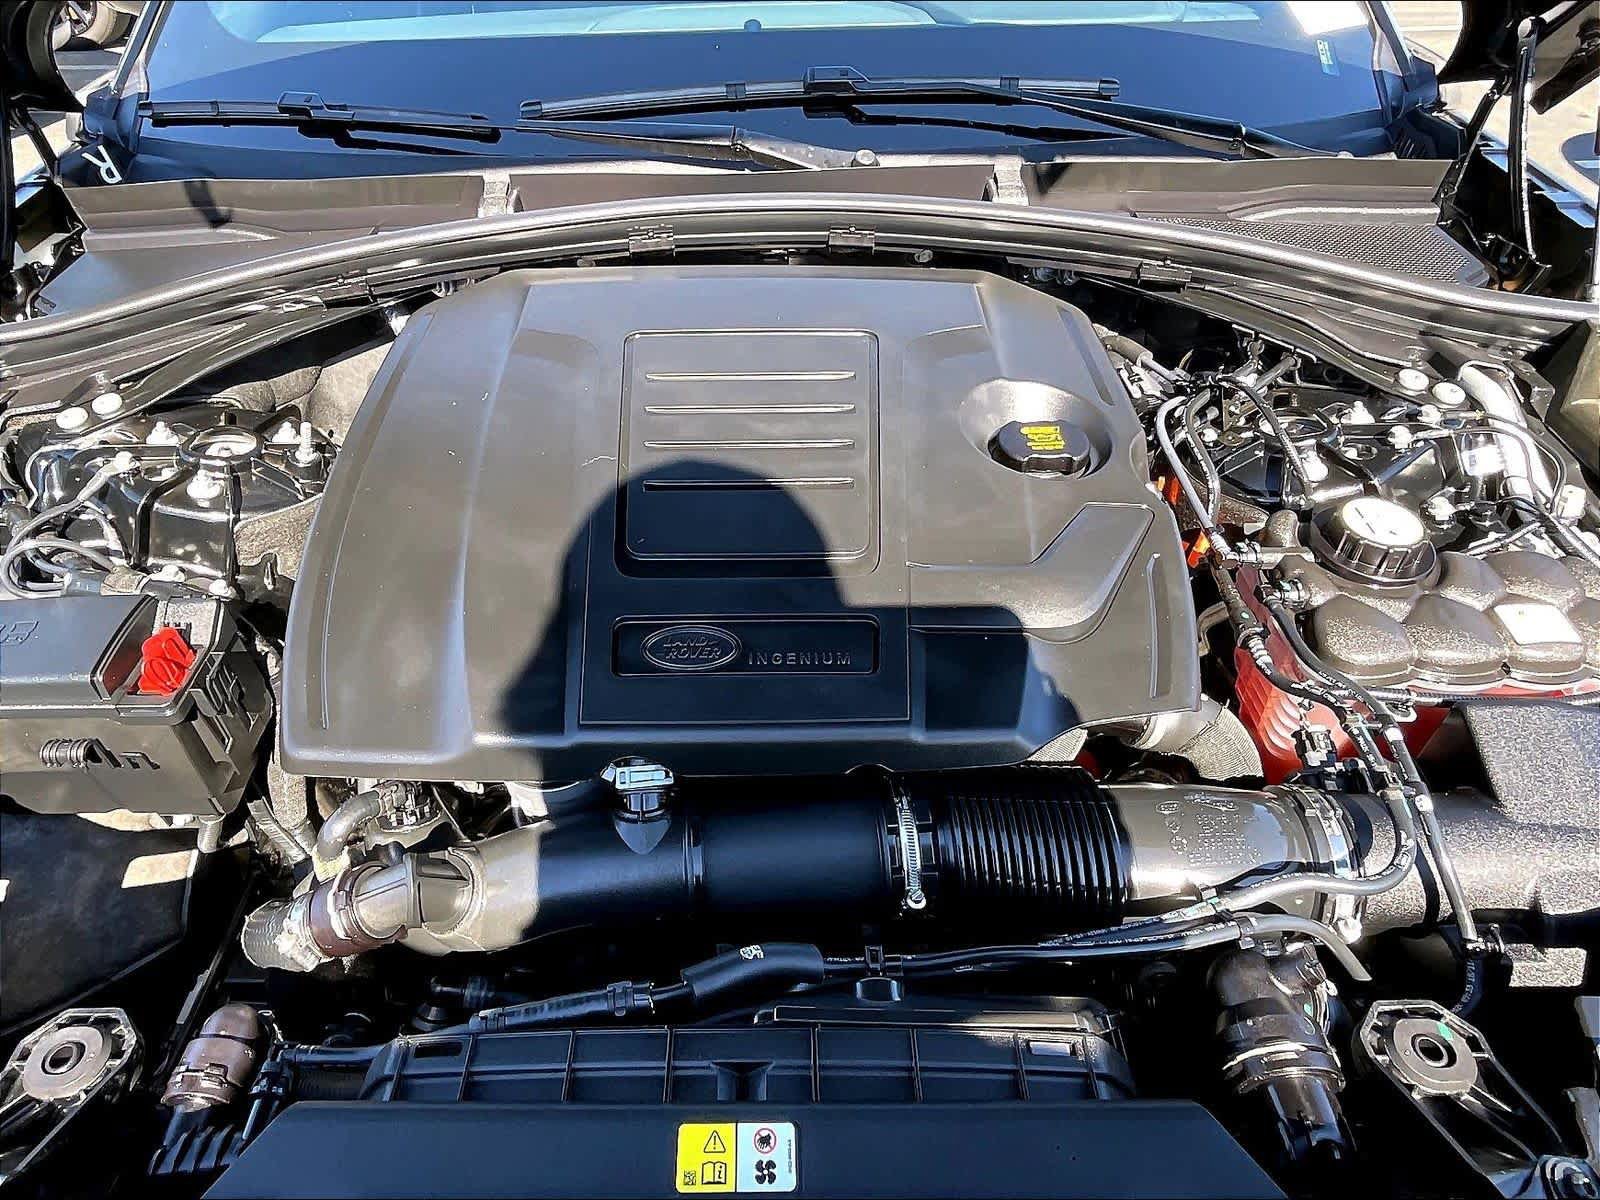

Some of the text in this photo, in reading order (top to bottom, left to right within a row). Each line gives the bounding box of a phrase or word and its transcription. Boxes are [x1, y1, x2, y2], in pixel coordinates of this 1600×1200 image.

[663, 638, 709, 648] LAND
[665, 647, 722, 660] ROVER
[748, 652, 851, 665] INGENIUM
